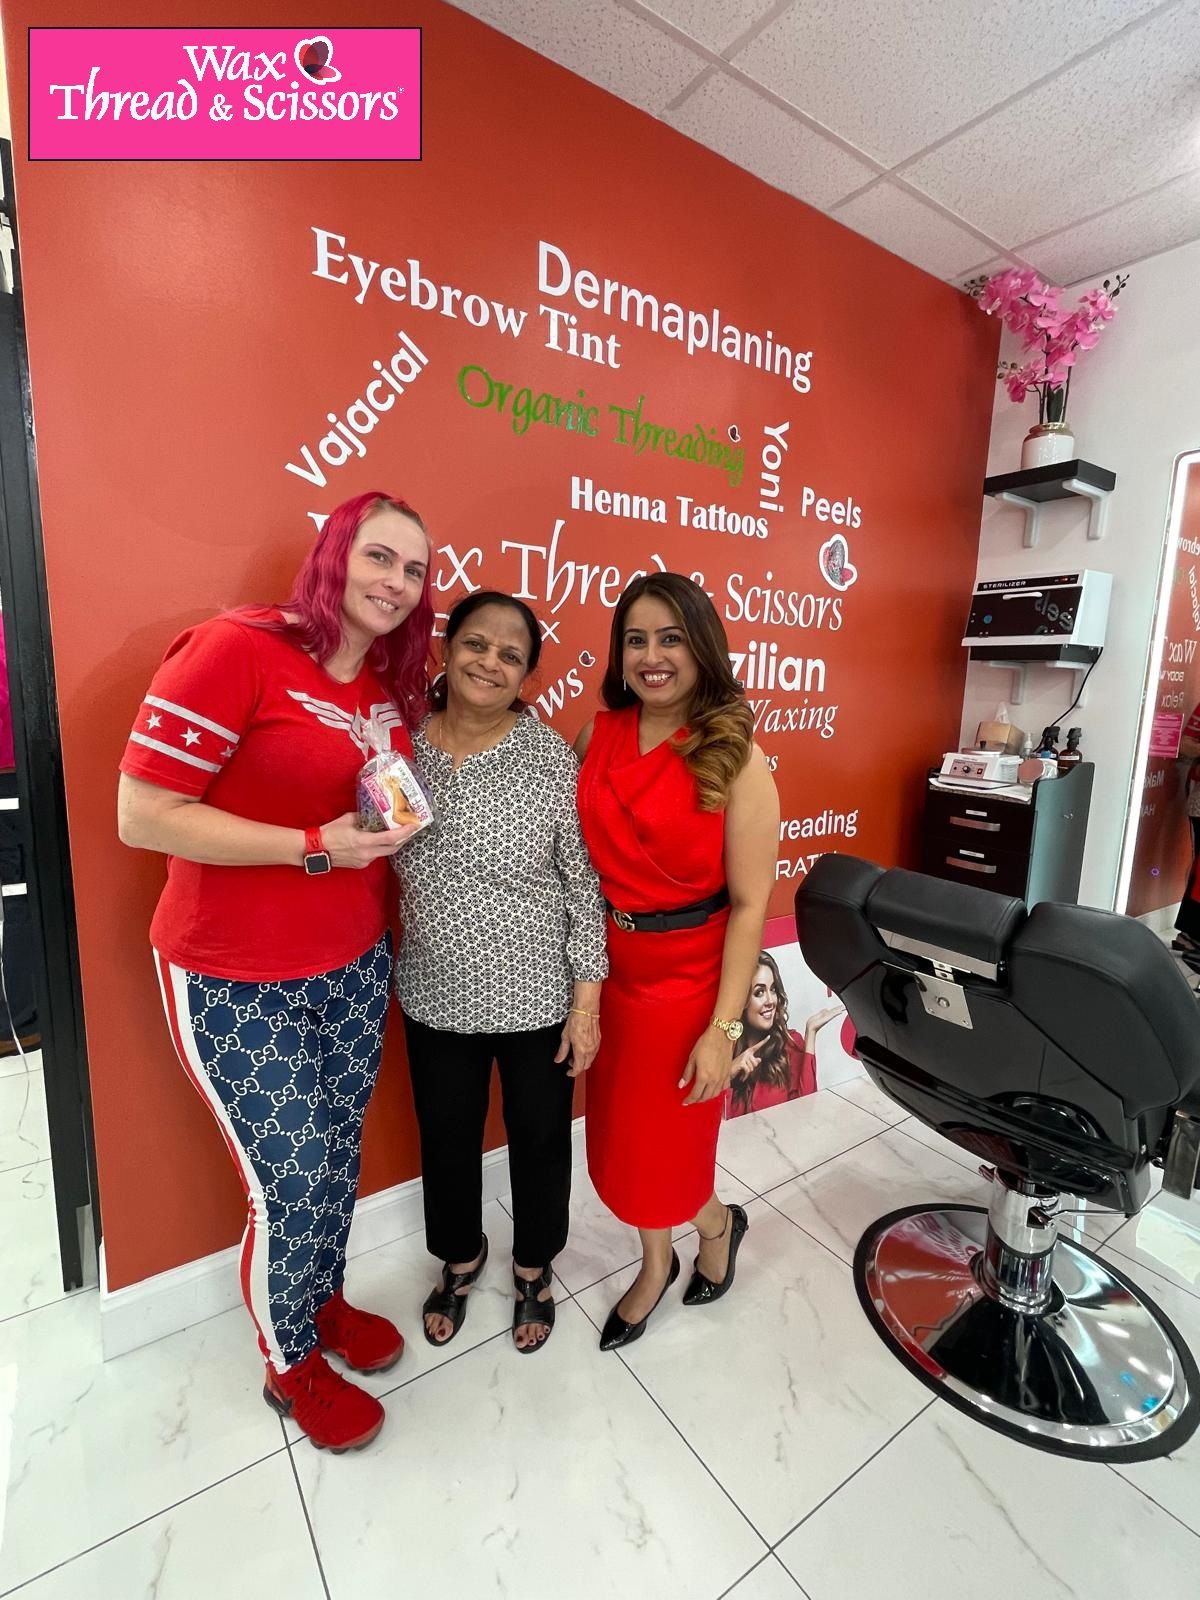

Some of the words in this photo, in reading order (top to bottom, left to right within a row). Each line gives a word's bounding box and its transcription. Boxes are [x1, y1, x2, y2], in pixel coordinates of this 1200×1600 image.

[311, 226, 528, 338] Eyebrow
[539, 304, 622, 369] Tint
[538, 240, 813, 394] Dermaplaning
[284, 330, 429, 488] Vajacial
[457, 364, 600, 436] Organic
[608, 395, 745, 487] Threading
[571, 476, 668, 523] Henna
[676, 496, 769, 539] Tattoos
[760, 421, 790, 513] Yoni
[802, 486, 862, 529] Peels
[725, 571, 843, 631] Scissors
[983, 580, 1027, 589] STERILIZER
